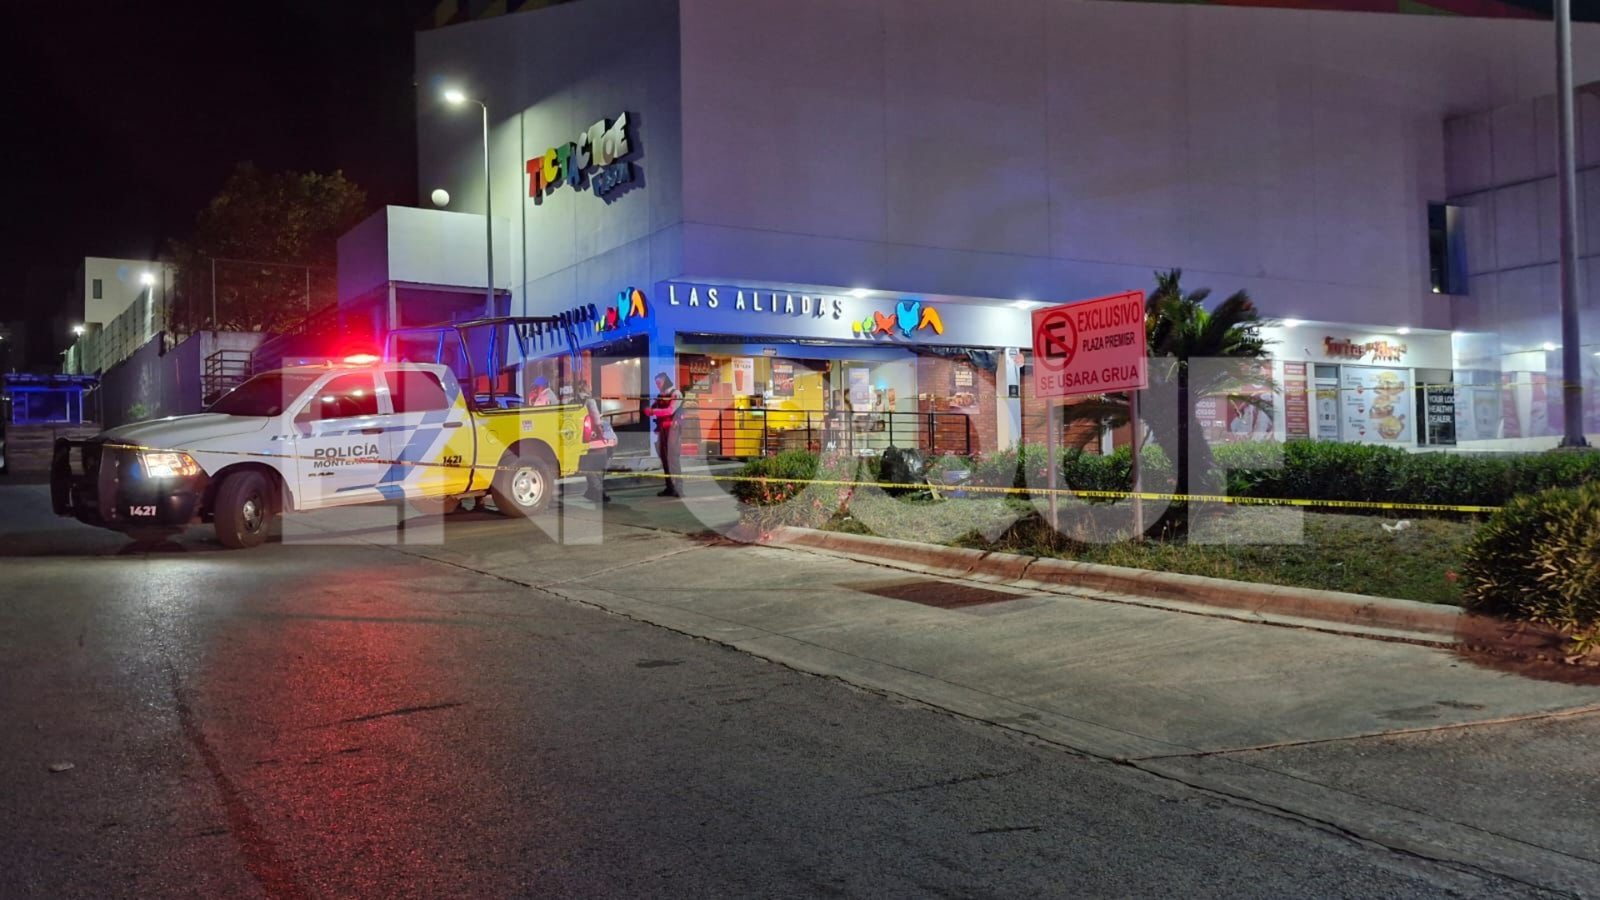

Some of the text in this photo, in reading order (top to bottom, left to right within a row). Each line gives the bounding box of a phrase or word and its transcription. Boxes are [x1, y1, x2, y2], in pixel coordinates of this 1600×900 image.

[669, 284, 843, 320] LAS ALIADAS
[1077, 301, 1140, 333] EXCLUSIVO
[1082, 331, 1136, 352] PLAZA PREMIER
[1040, 364, 1139, 390] SE USARA GRUA
[1429, 395, 1444, 404] YOUR
[1428, 405, 1454, 414] HEALTHY
[314, 443, 379, 458] POLICÍA
[313, 455, 379, 469] MONTEY
[443, 455, 462, 465] 1421
[129, 505, 157, 517] 1421
